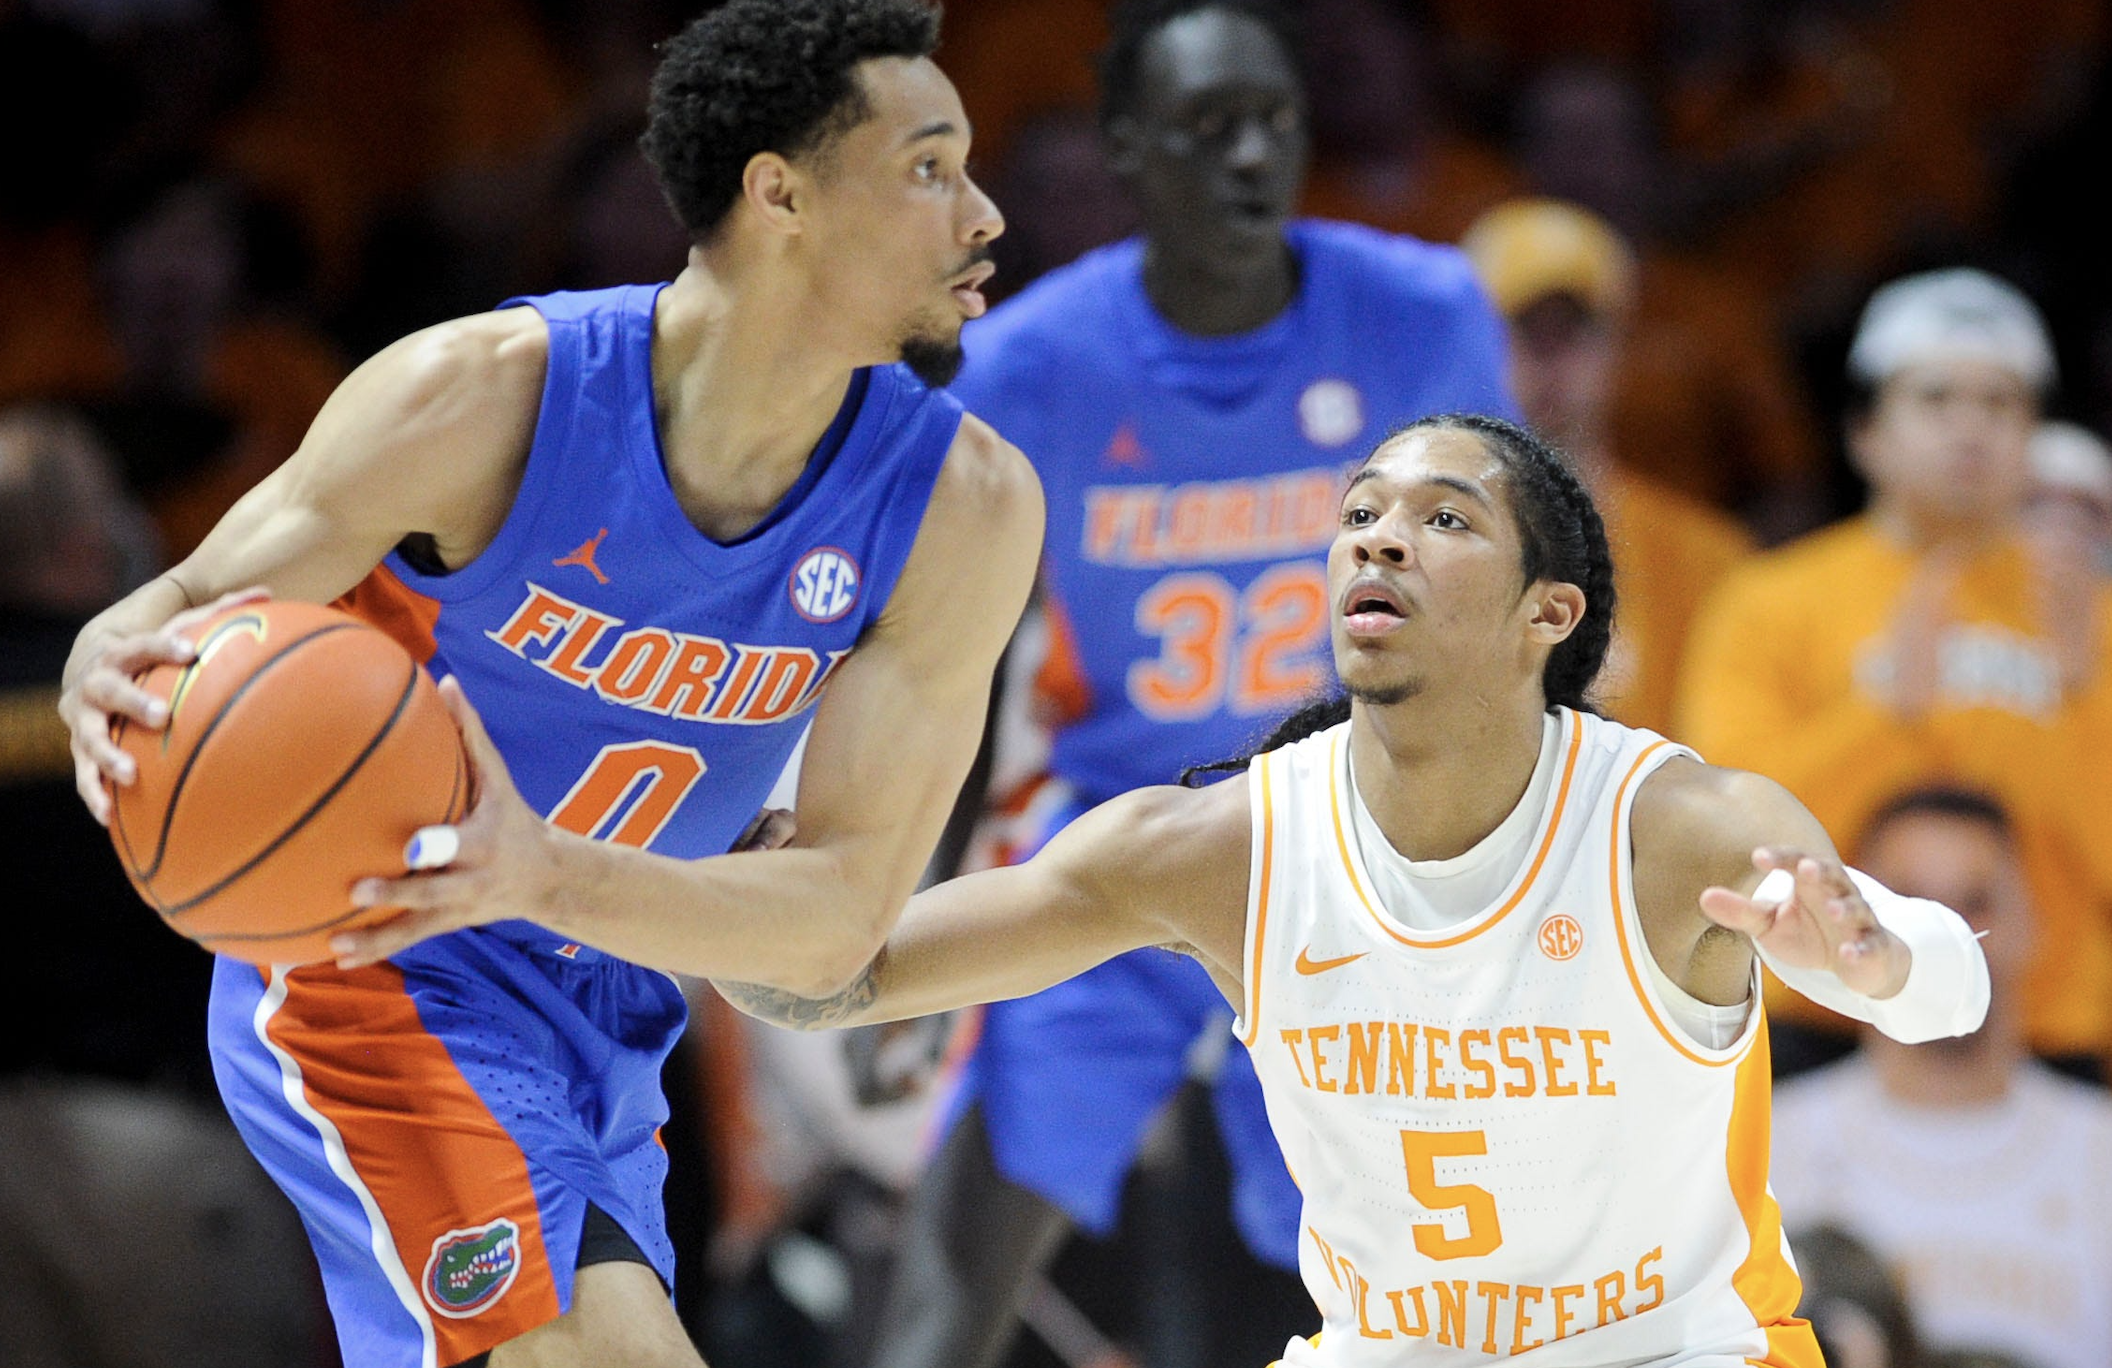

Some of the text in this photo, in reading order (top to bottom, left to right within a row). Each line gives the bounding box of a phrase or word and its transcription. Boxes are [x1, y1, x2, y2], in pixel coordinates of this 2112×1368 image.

[1083, 464, 1345, 567] FLORID
[795, 551, 856, 617] SEC
[485, 581, 853, 725] FLORID
[1127, 560, 1330, 722] 32
[1543, 919, 1578, 956] SEC
[1280, 1021, 1617, 1099] TENNESSEE
[1400, 1129, 1503, 1261] 5
